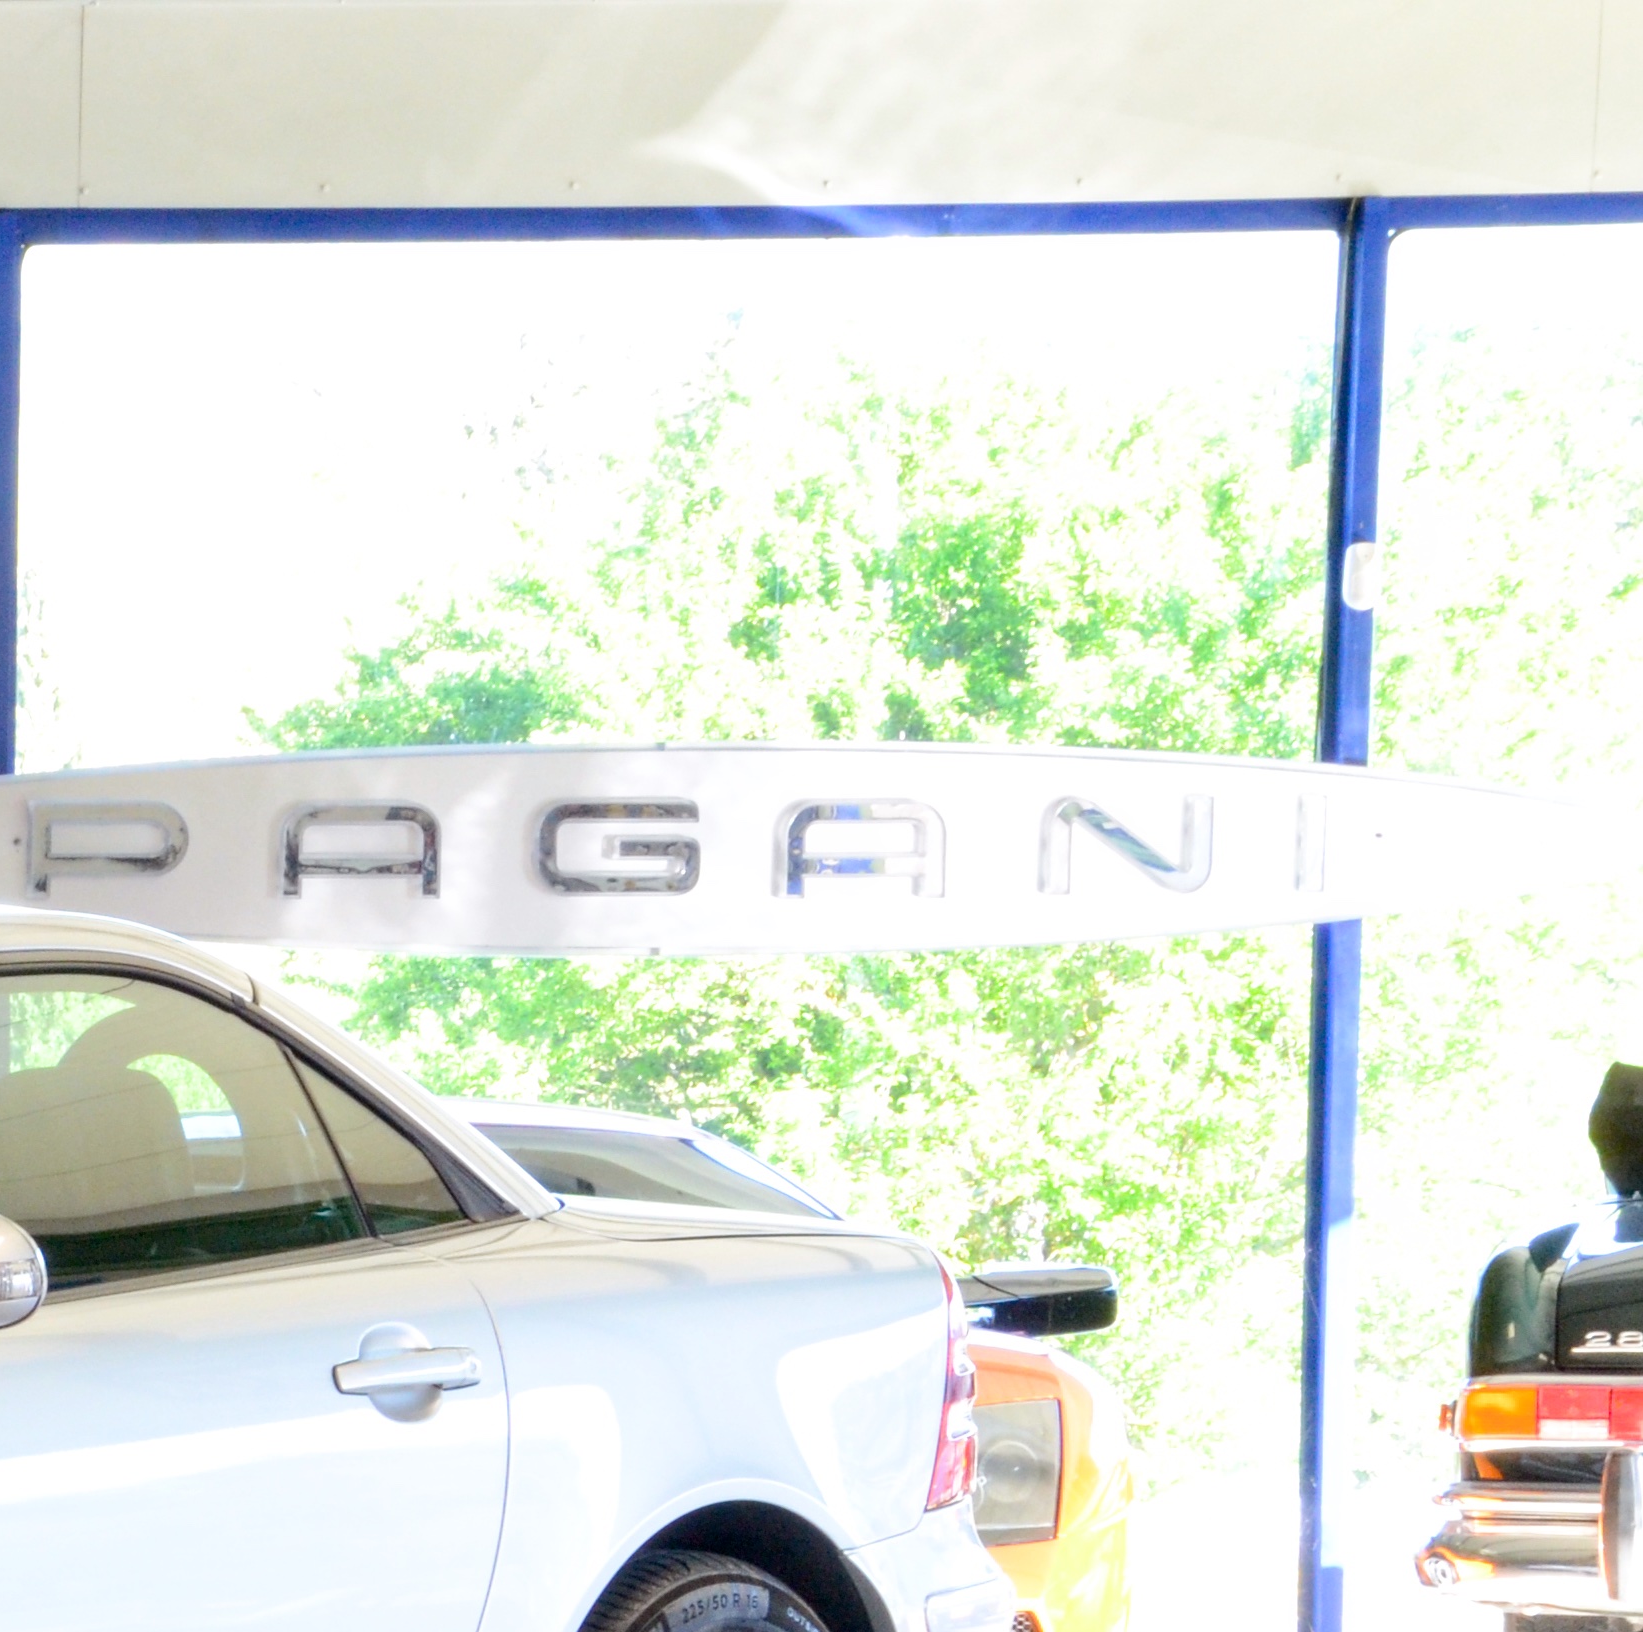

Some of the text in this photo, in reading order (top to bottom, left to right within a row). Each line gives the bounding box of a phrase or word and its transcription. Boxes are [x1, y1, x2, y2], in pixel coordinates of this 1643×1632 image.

[27, 797, 1327, 900] PAGANI
[681, 1593, 728, 1624] 225/50
[746, 1594, 759, 1609] 16
